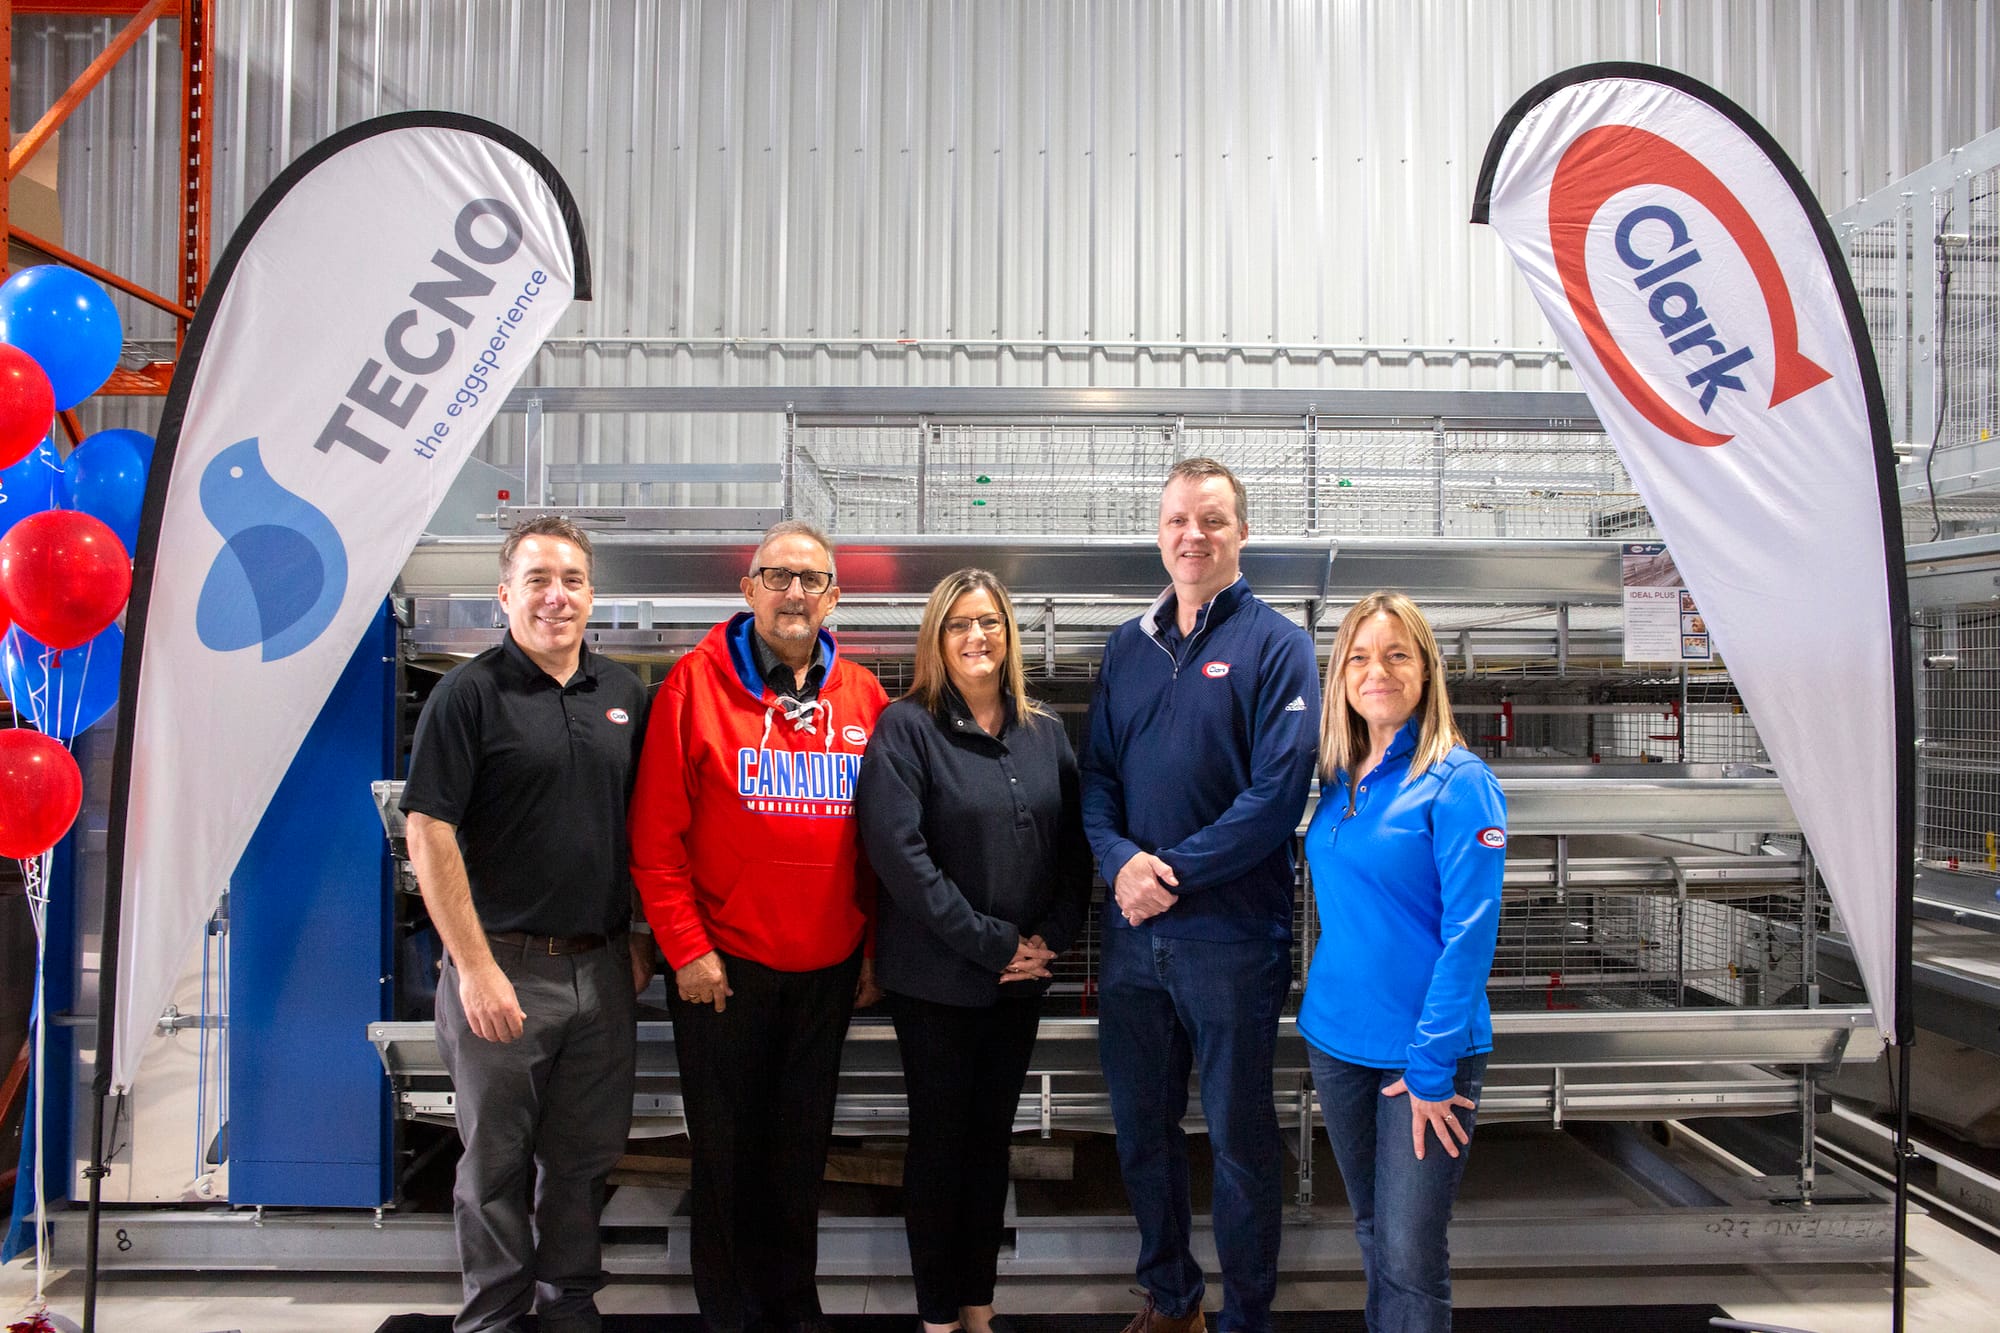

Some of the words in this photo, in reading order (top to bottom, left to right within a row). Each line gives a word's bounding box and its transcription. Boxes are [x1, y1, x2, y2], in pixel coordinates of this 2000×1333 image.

[313, 198, 523, 465] TECNO
[413, 421, 450, 460] the
[446, 269, 548, 417] eggsperience
[1614, 205, 1754, 416] Clark
[1630, 591, 1654, 599] IDEAL
[1654, 591, 1676, 599] PLUS
[738, 747, 864, 802] CANADIEN
[747, 801, 817, 814] MONTREAL
